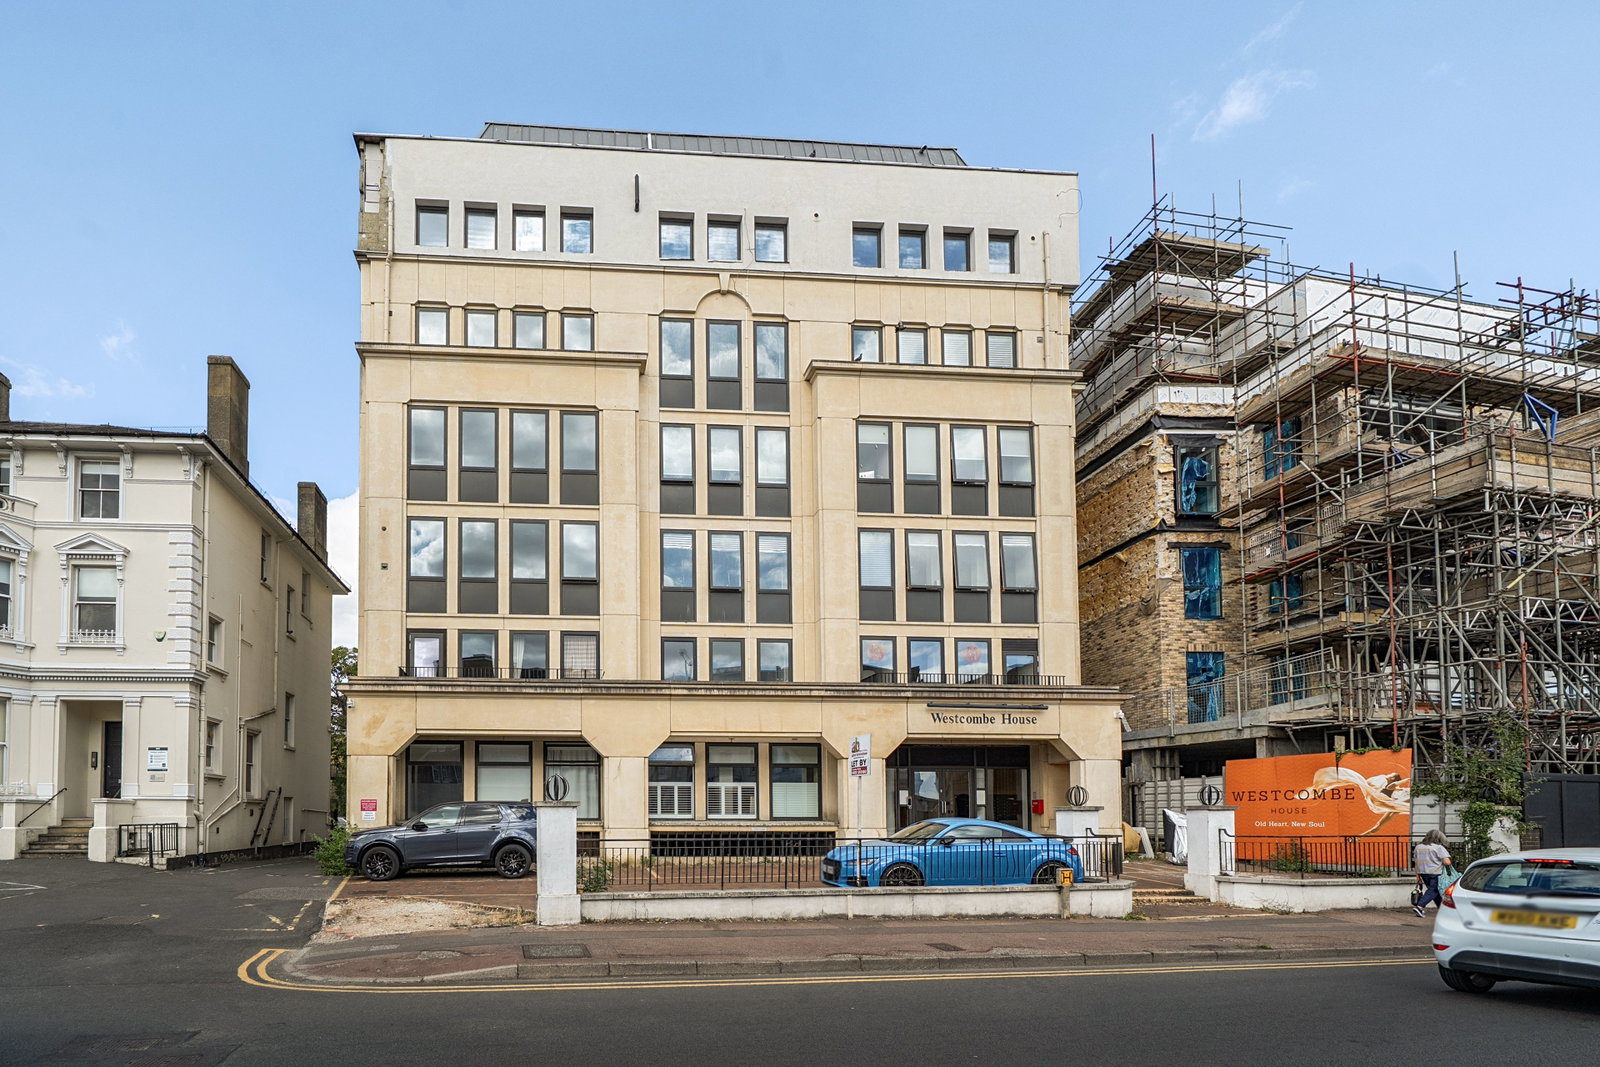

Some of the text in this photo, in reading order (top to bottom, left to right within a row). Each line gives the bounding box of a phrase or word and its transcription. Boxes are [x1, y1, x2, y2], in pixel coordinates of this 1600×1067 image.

[931, 712, 1038, 724] Westcombe House
[1232, 788, 1355, 802] WESTCOMBE
[1271, 807, 1307, 815] HOUSE
